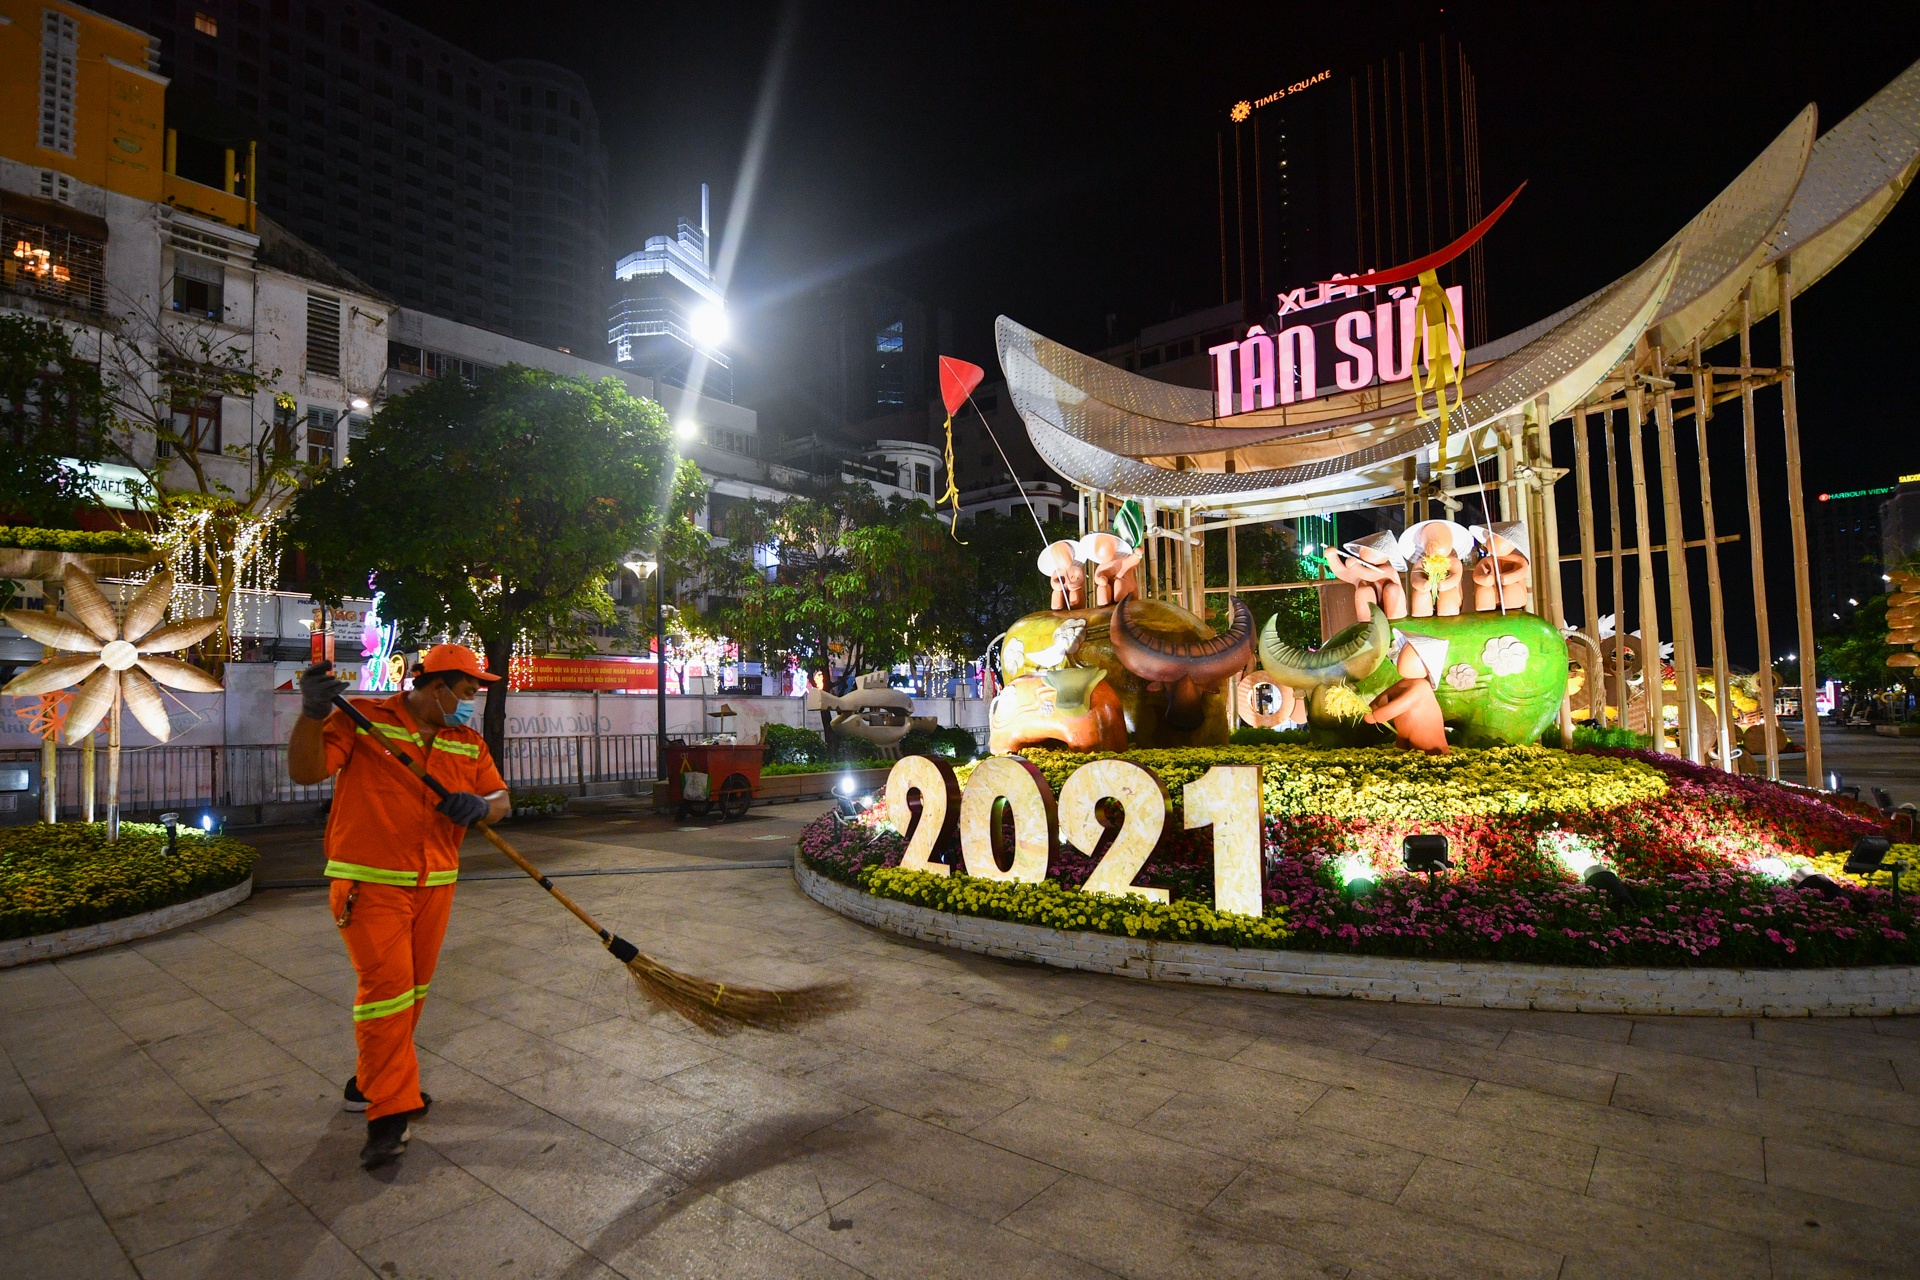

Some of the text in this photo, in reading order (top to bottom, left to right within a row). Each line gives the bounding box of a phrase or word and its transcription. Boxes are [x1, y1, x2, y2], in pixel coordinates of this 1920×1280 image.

[1254, 69, 1332, 109] TIMES SQUARE
[1208, 324, 1317, 418] TÂN
[124, 481, 152, 496] BER
[1829, 490, 1866, 499] HARBOUR
[1868, 487, 1888, 495] VIEW
[886, 754, 1264, 919] 2021
